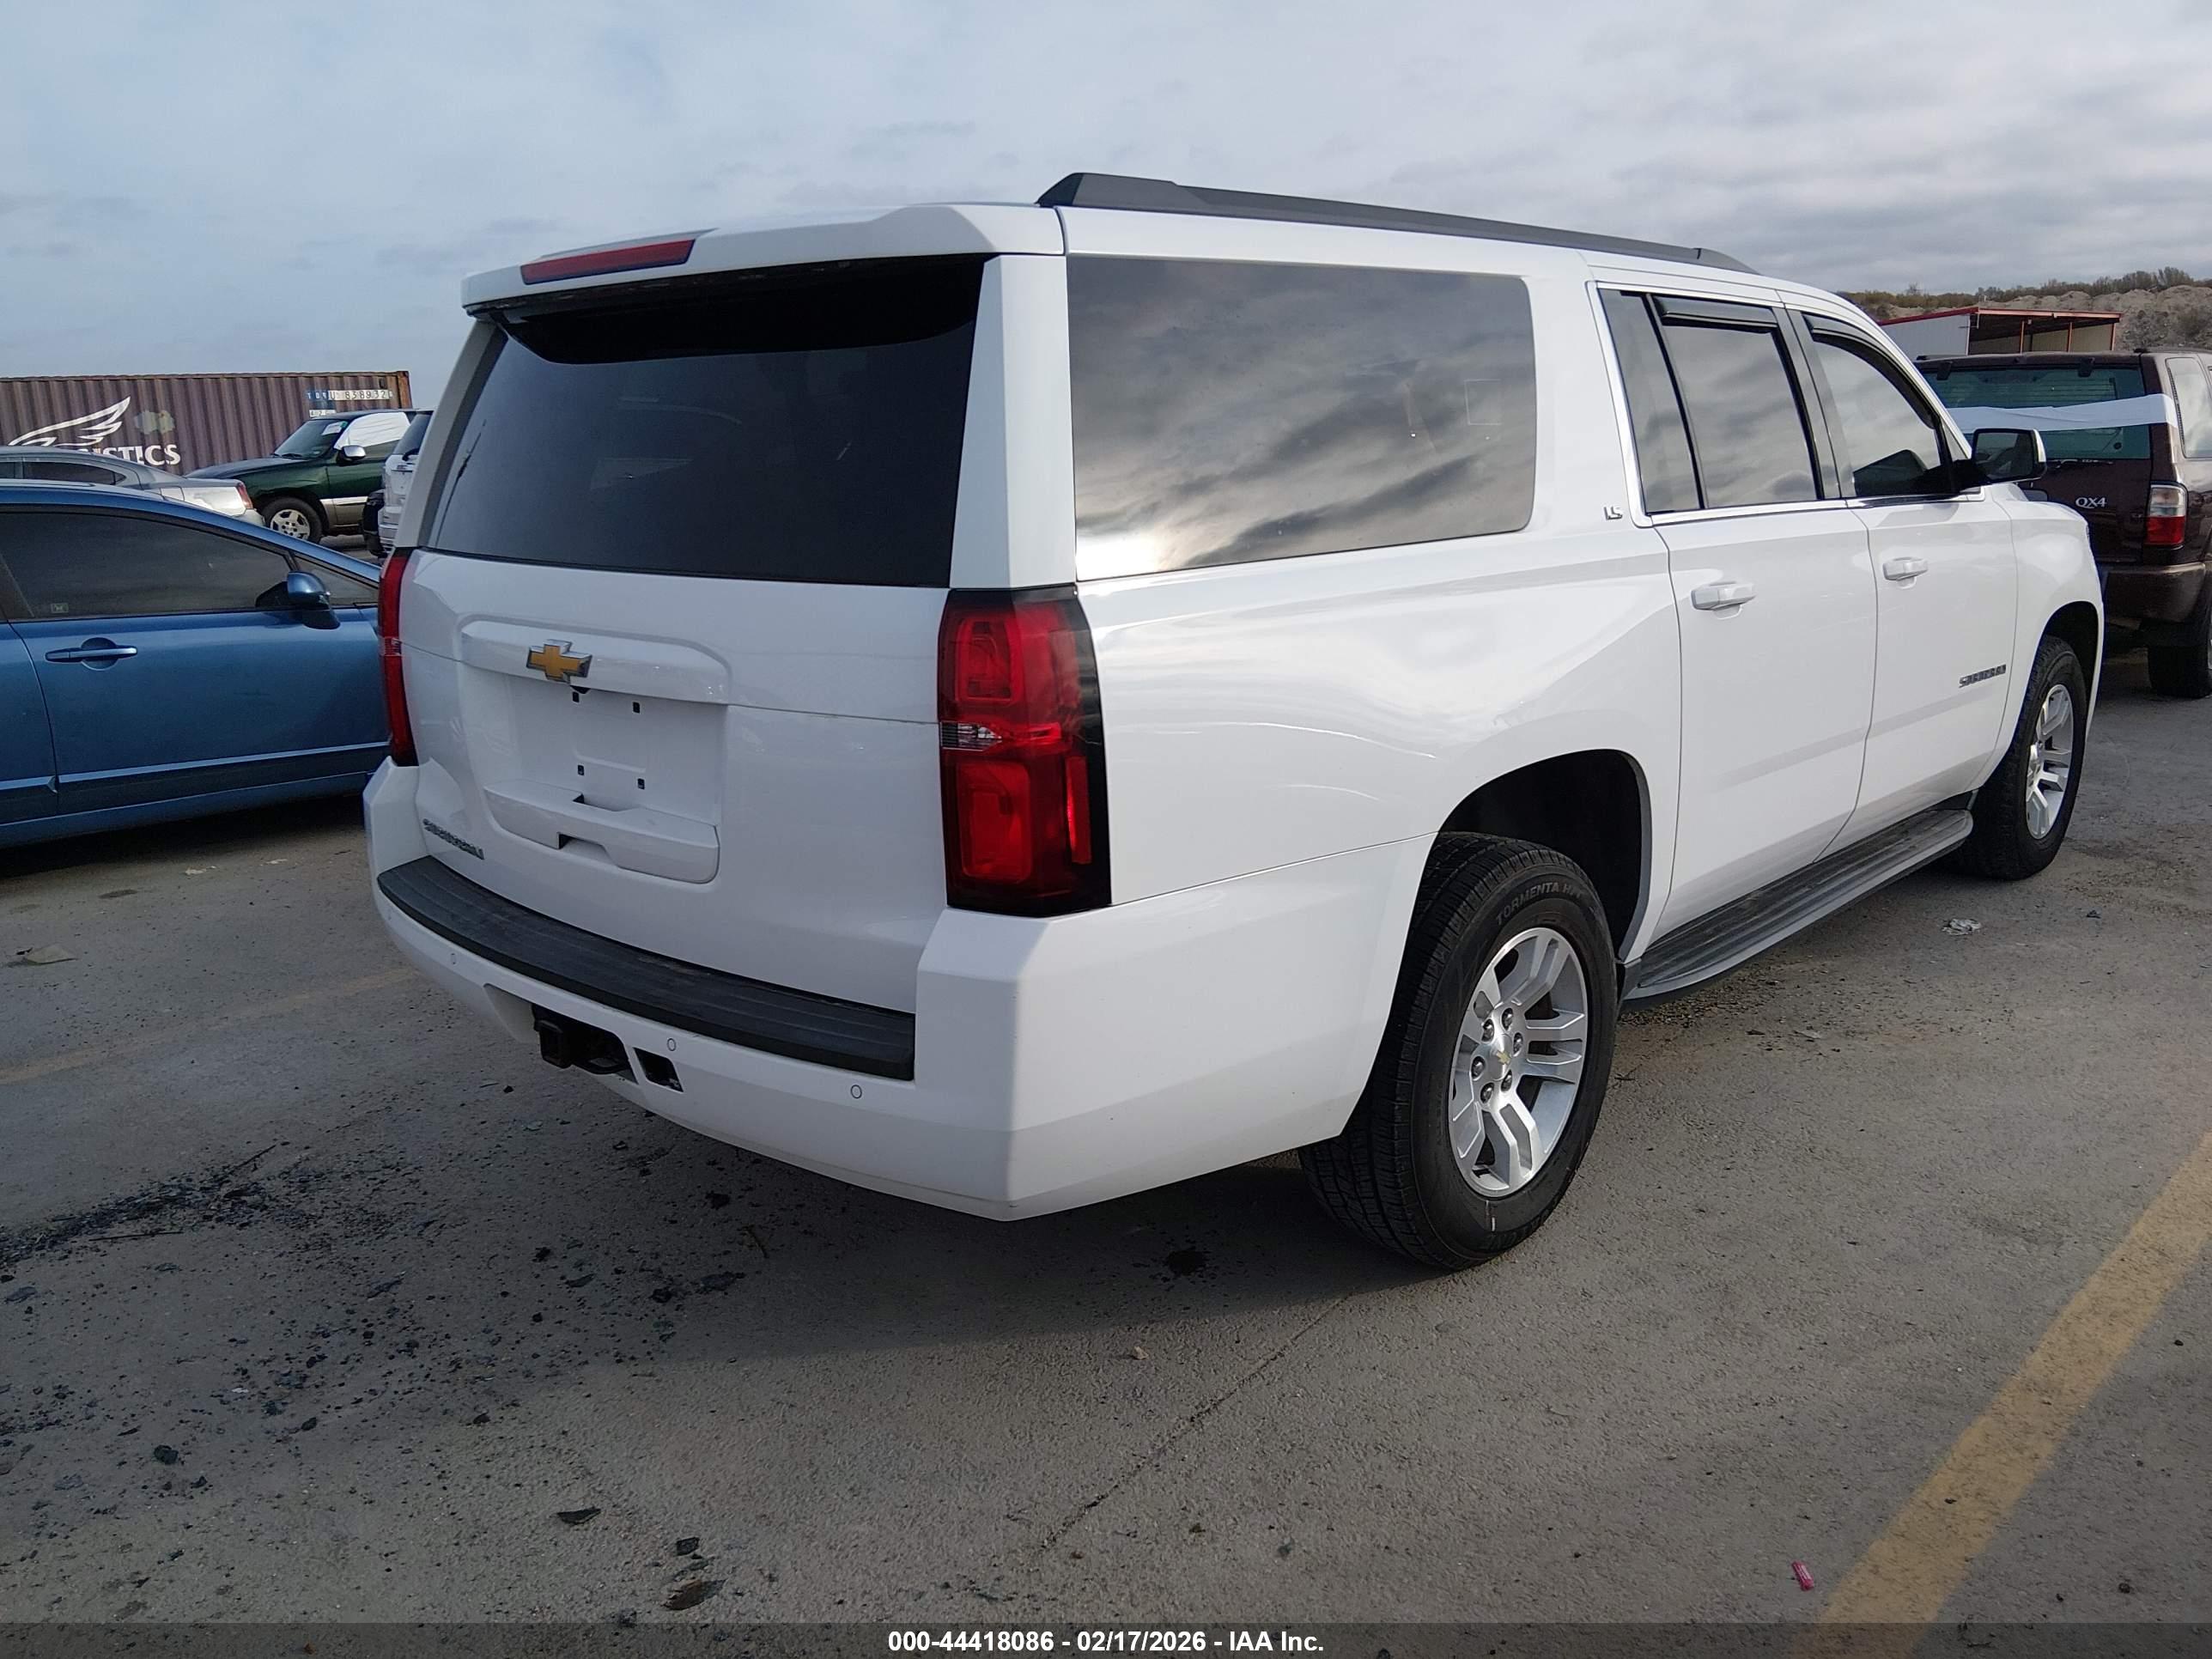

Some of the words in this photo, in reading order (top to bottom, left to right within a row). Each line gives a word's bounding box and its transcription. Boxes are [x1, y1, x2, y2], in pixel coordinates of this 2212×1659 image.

[78, 444, 181, 466] STICS
[2075, 497, 2107, 509] QX4
[1603, 506, 1623, 520] LS
[1496, 882, 1560, 925] TORMENTA
